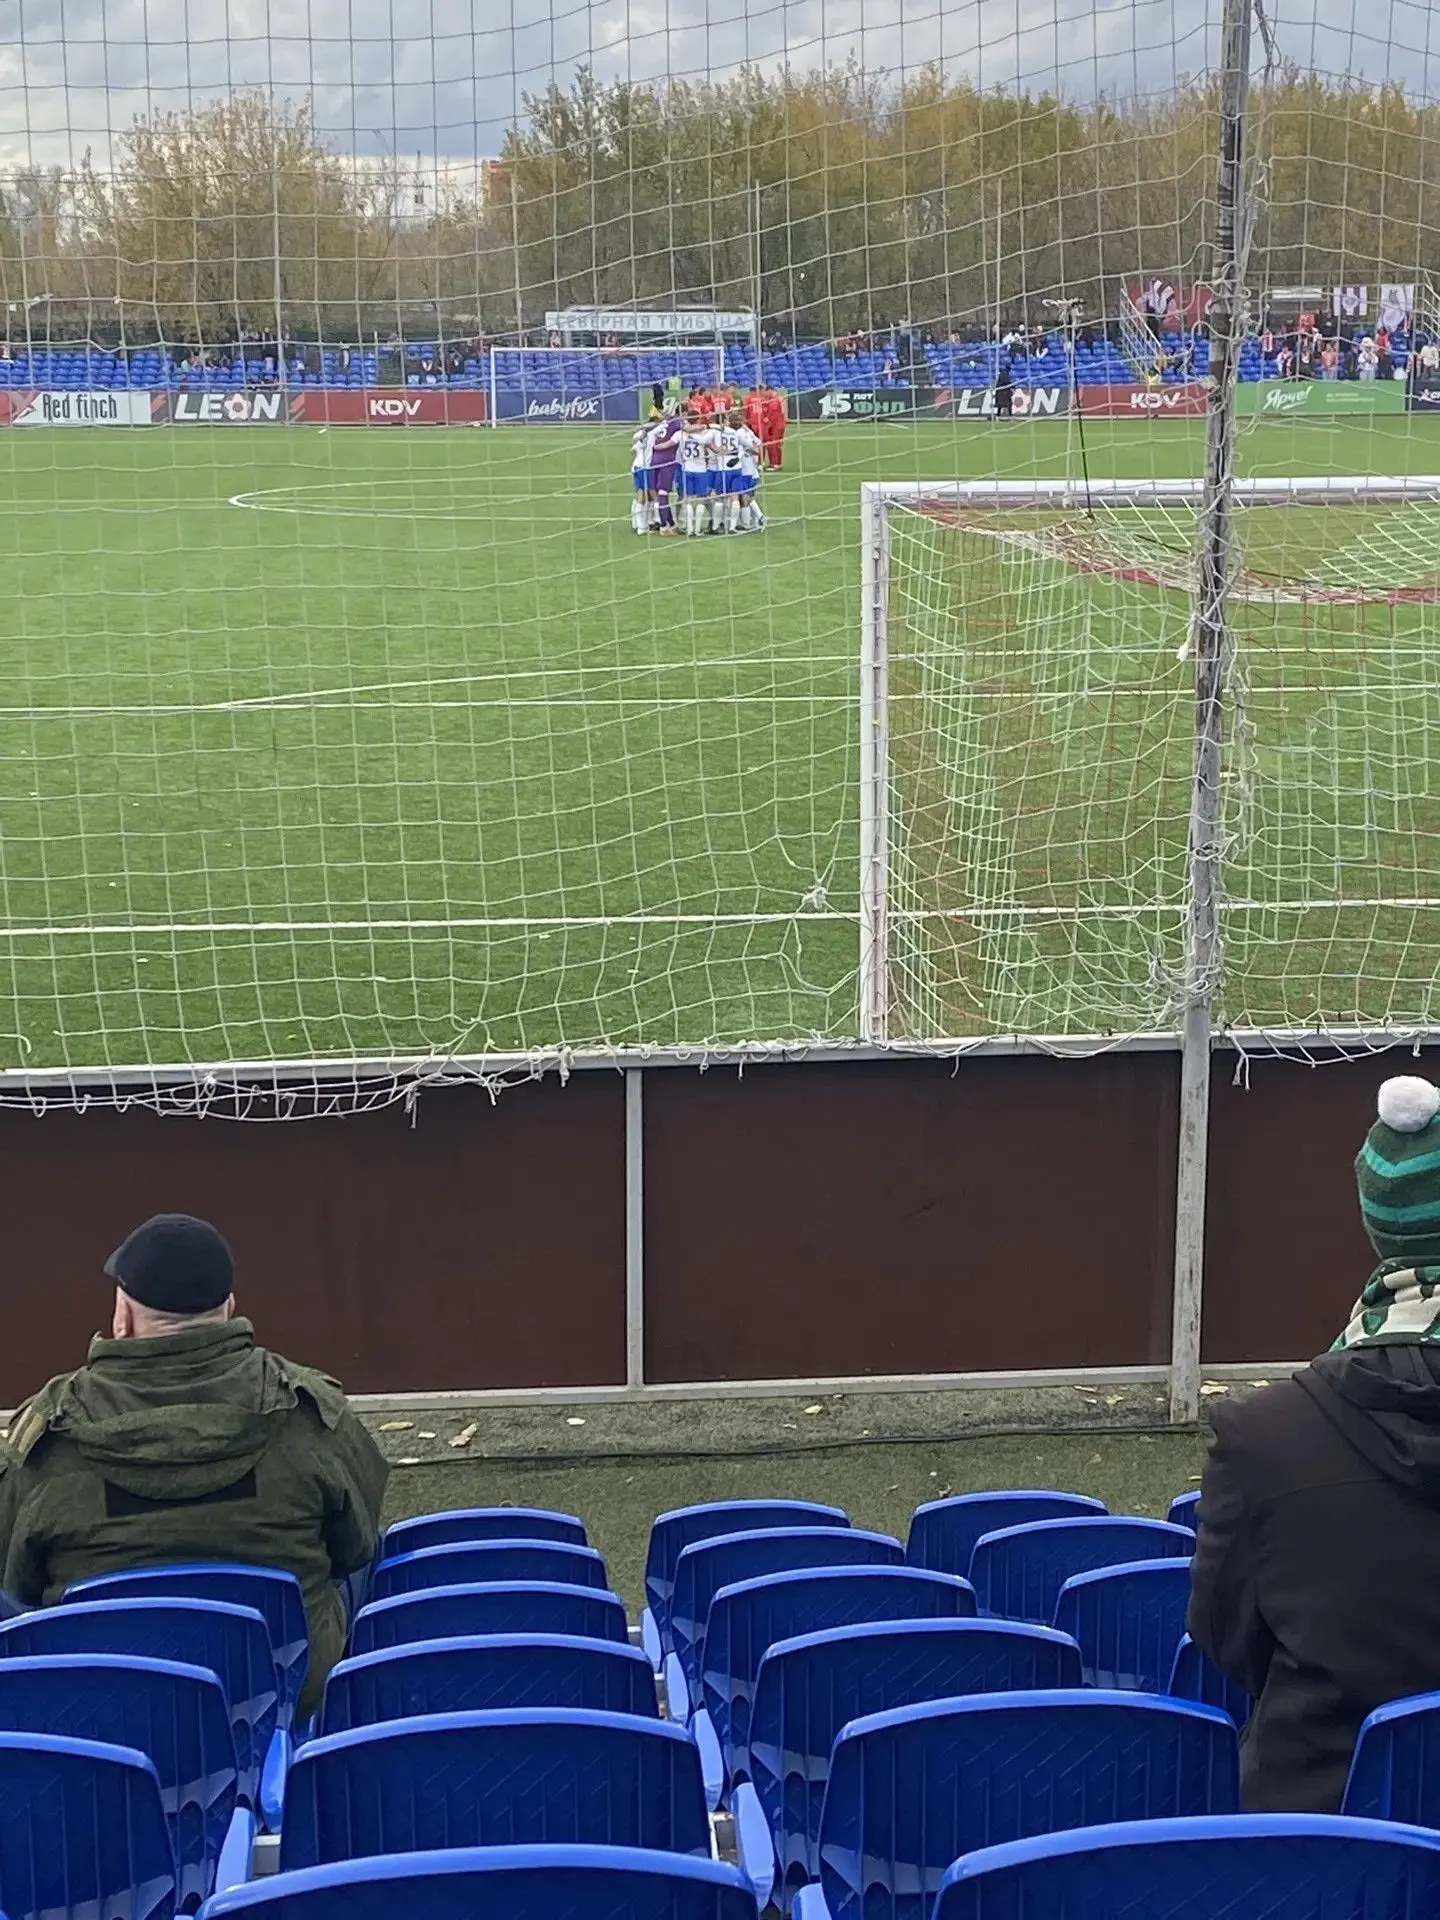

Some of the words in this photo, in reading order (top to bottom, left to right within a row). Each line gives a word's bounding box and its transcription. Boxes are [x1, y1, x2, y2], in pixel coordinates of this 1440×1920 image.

[558, 315, 650, 329] СЕВЕРНАЯ
[659, 315, 746, 329] ТРИБУНА
[42, 393, 70, 420] Red
[75, 393, 117, 419] finch
[175, 393, 281, 420] LEON
[369, 399, 422, 416] KDV
[528, 396, 599, 419] babyfox
[818, 393, 852, 417] 15
[1130, 391, 1181, 409] KDV
[684, 440, 700, 458] 53
